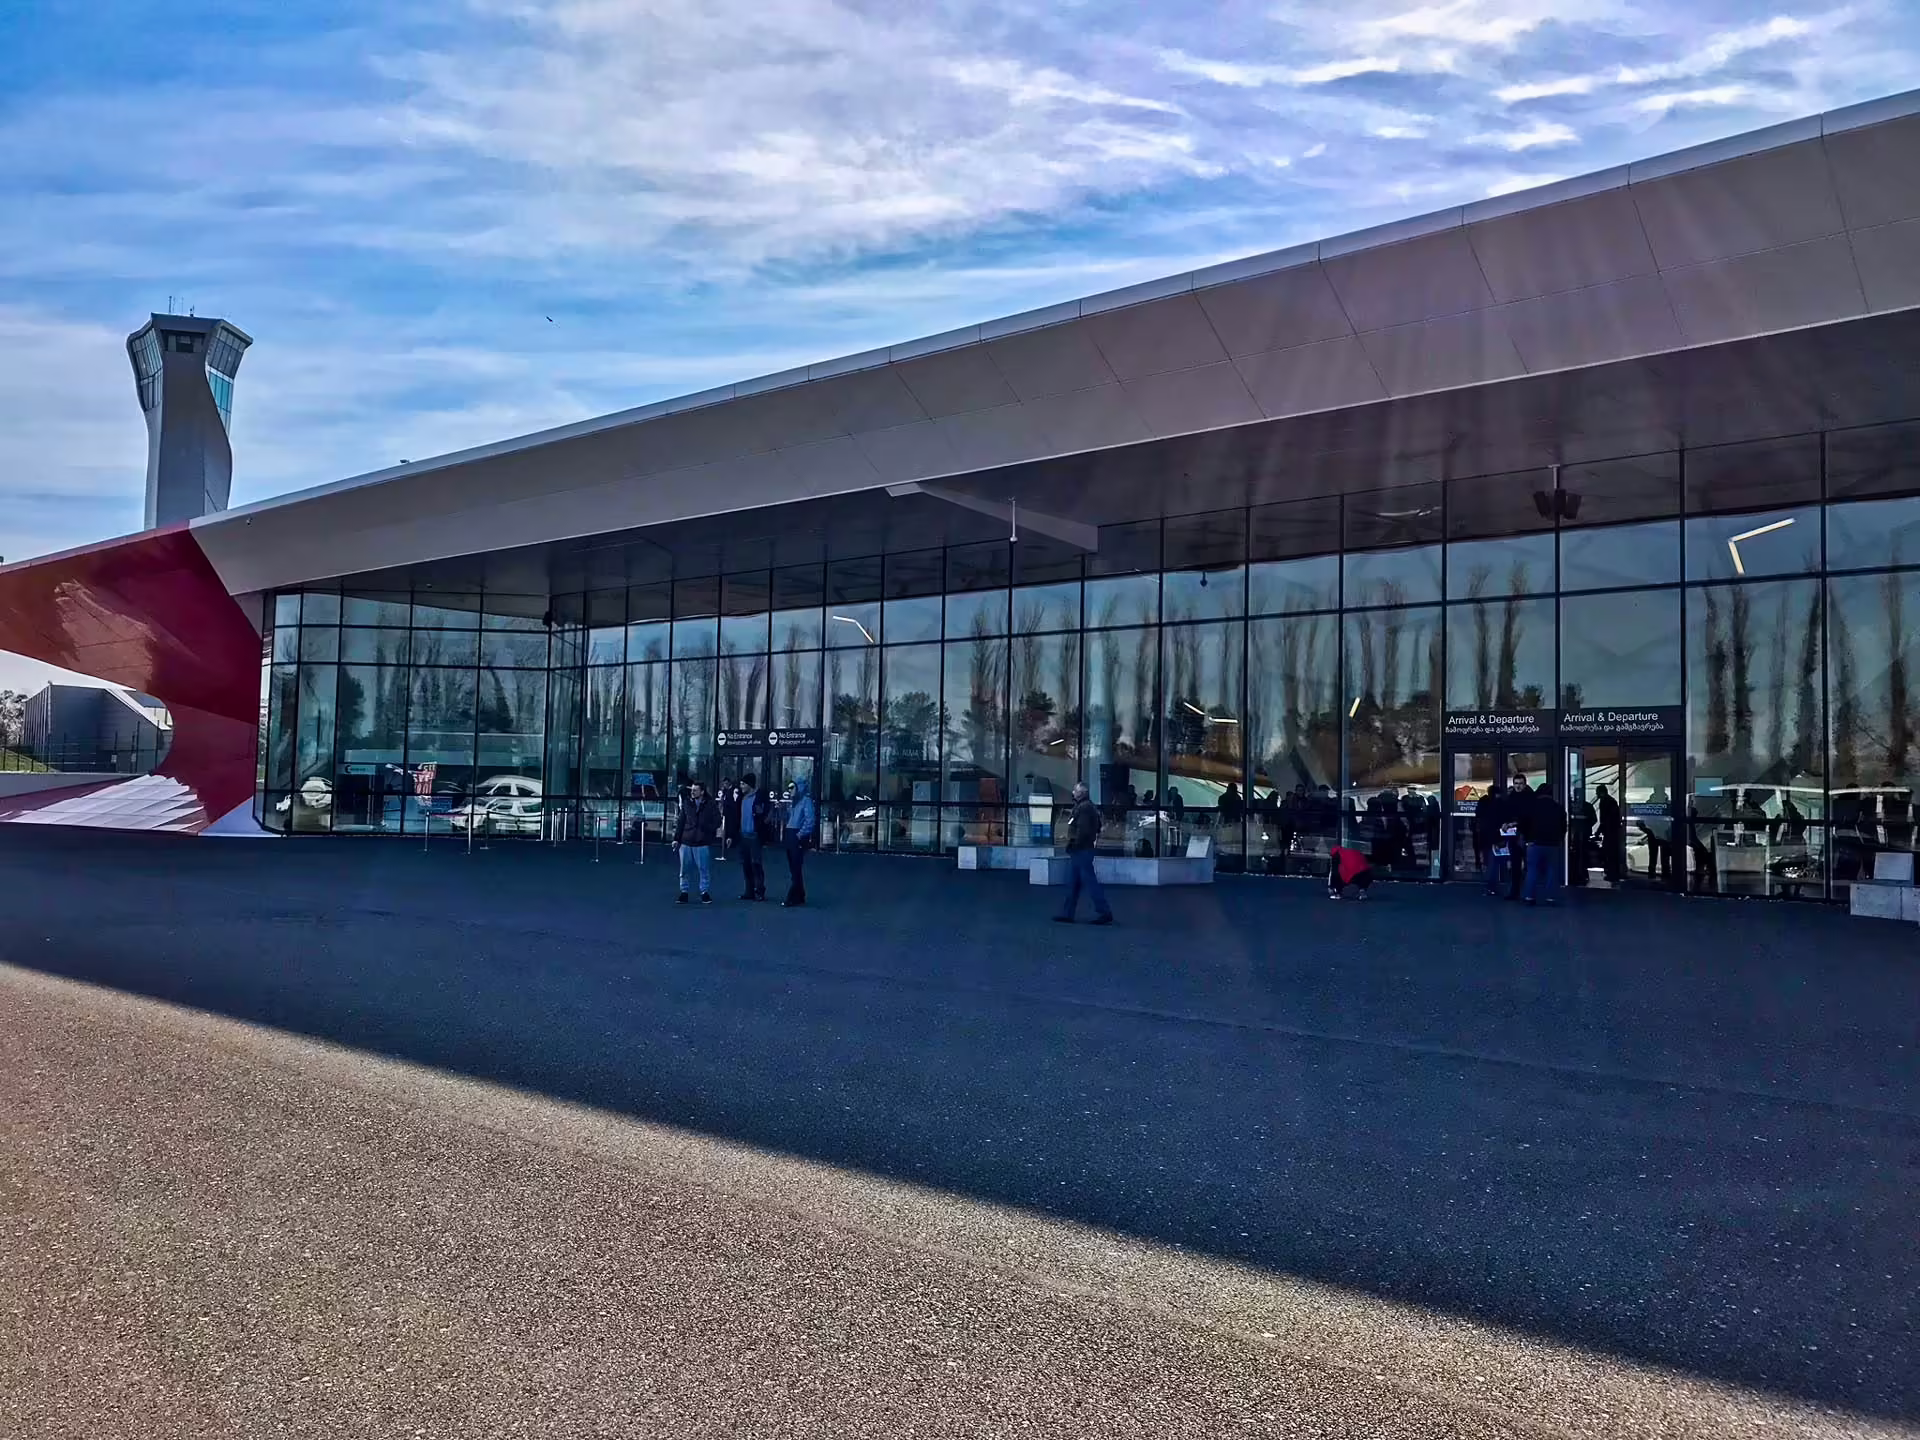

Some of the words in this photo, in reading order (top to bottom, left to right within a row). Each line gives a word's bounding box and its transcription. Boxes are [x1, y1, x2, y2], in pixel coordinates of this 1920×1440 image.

[1447, 715, 1477, 725] Arrival
[1479, 715, 1486, 724] &
[1489, 714, 1535, 725] Departure
[1563, 713, 1595, 722] Arrival
[1598, 712, 1605, 722] &
[1608, 712, 1658, 723] Departure
